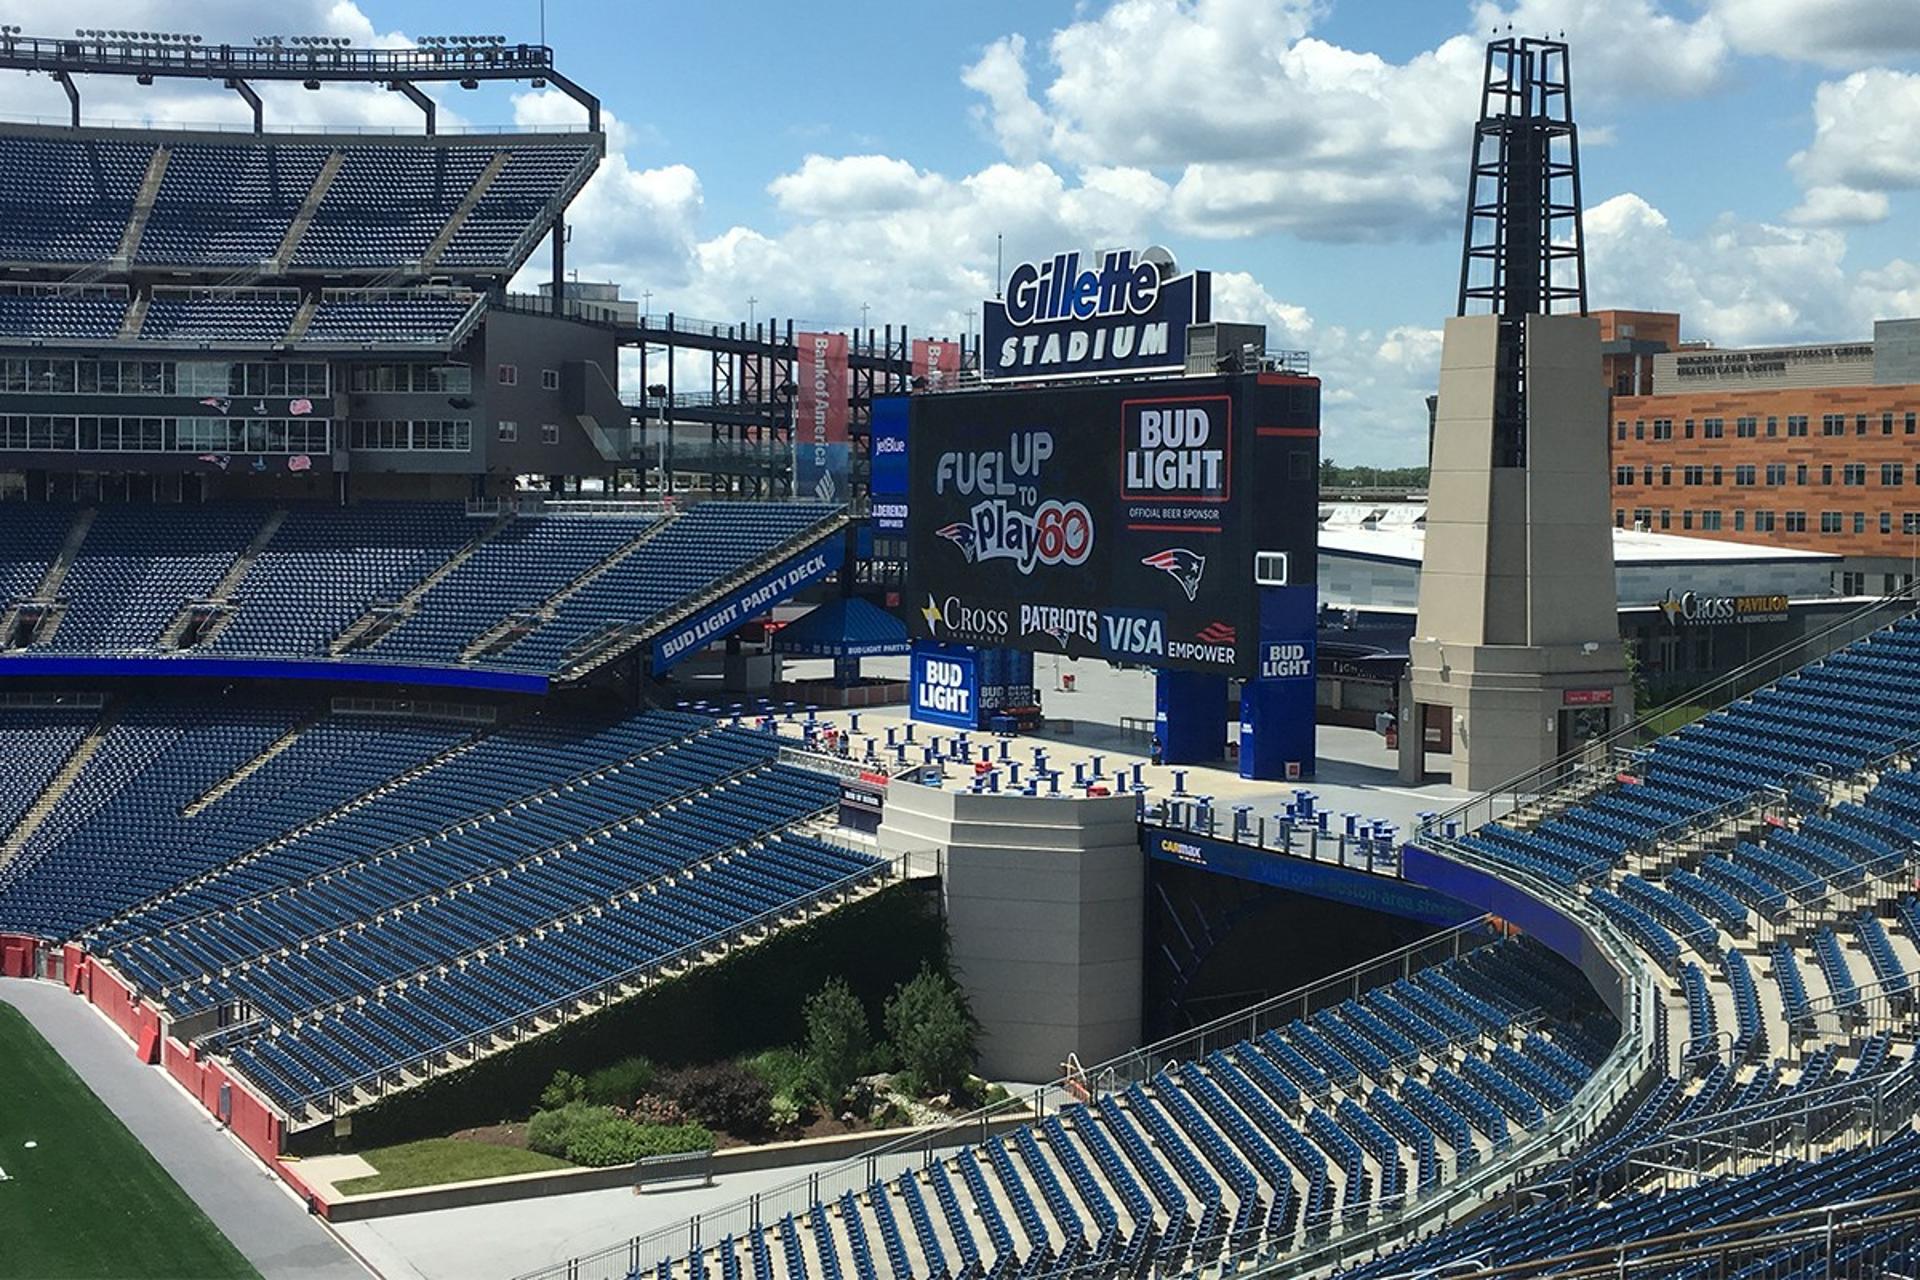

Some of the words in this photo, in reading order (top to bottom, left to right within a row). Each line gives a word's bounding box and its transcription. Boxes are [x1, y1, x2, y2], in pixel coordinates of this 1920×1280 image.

[1005, 247, 1160, 326] Gillette
[815, 338, 829, 379] Bank
[1000, 322, 1168, 368] STADIUM
[815, 379, 829, 399] of
[815, 399, 829, 466] America
[876, 436, 905, 456] jetBlue
[1140, 408, 1210, 449] BUD
[936, 451, 1016, 496] FUEL
[1011, 431, 1054, 476] UP
[1127, 449, 1223, 490] LIGHT
[1019, 486, 1038, 507] TO
[1128, 508, 1161, 518] OFFICIAL
[1162, 508, 1181, 519] BEER
[1183, 508, 1220, 520] SPONSOR
[662, 631, 696, 659] BUD
[697, 605, 737, 639] LIGHT
[741, 576, 788, 612] PARTY
[788, 554, 827, 586] DECK
[943, 596, 1009, 636] CROSS
[1020, 604, 1098, 644] PATRIOTS
[1681, 590, 1735, 620] CROSS
[1737, 596, 1788, 613] PAVILION
[1102, 615, 1164, 656] VISA
[1167, 641, 1236, 665] EMPOWER
[1269, 644, 1305, 661] BUD
[926, 660, 963, 687] BUD
[1263, 660, 1311, 677] LIGHT
[919, 683, 970, 713] LIGHT
[981, 686, 1005, 697] BUD
